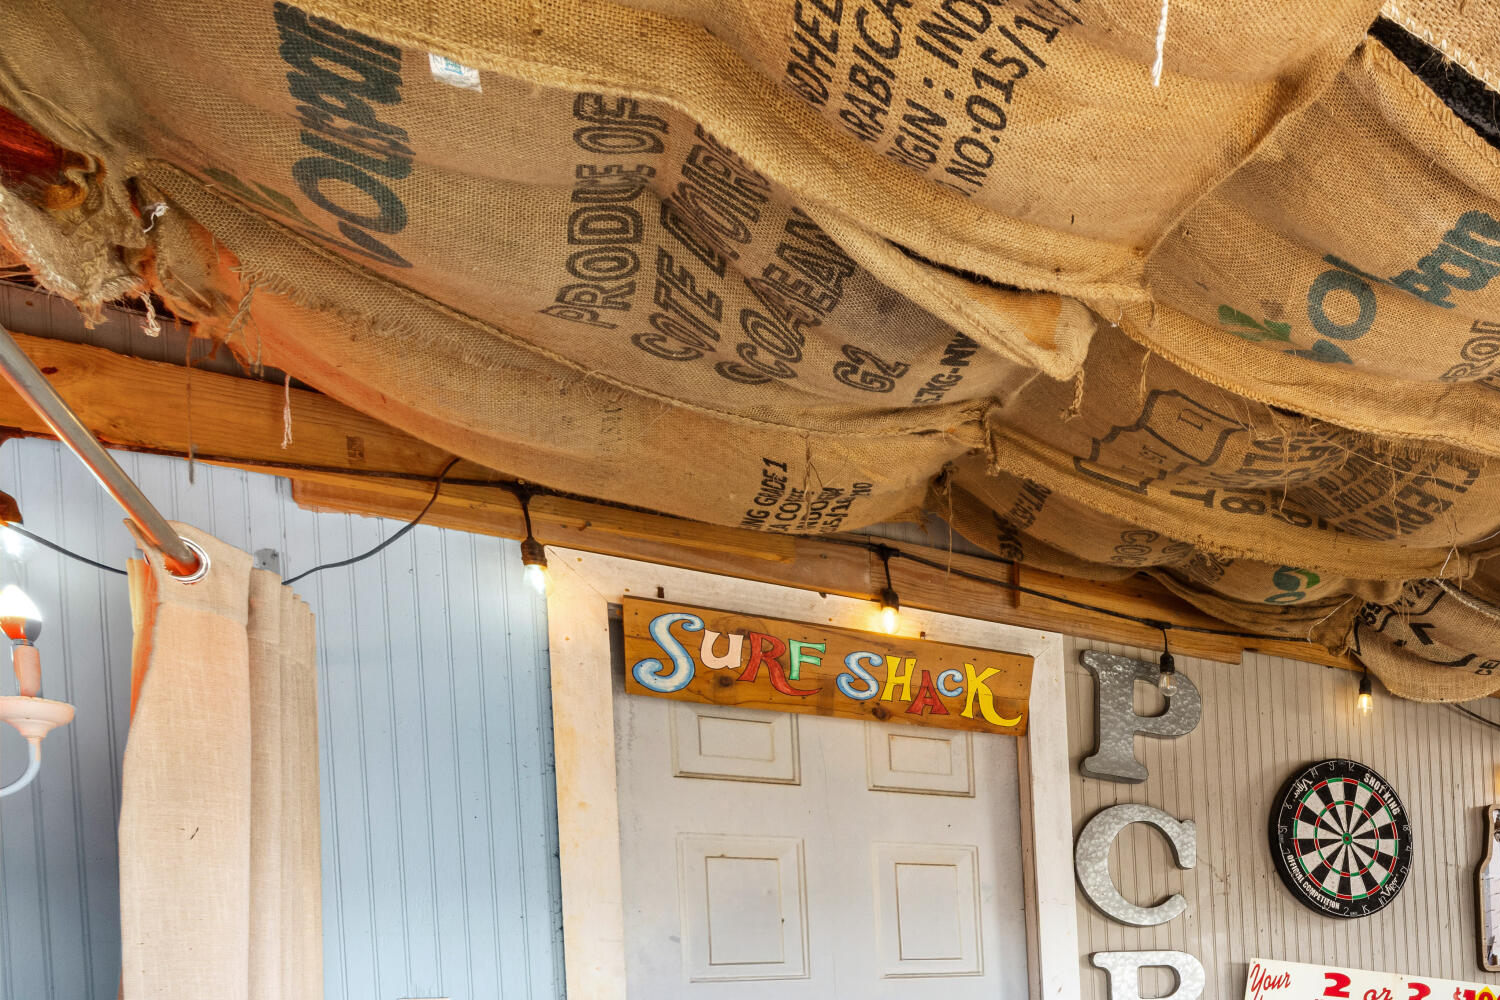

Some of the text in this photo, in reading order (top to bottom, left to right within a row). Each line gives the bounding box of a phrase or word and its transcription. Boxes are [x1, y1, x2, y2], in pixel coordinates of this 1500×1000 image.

[632, 612, 1024, 728] SURF SHACK
[1363, 773, 1401, 816] SHOT KING
[1287, 853, 1341, 910] OFFICIAL COMPETITION
[1250, 963, 1291, 1000] Your
[1323, 972, 1351, 999] 2
